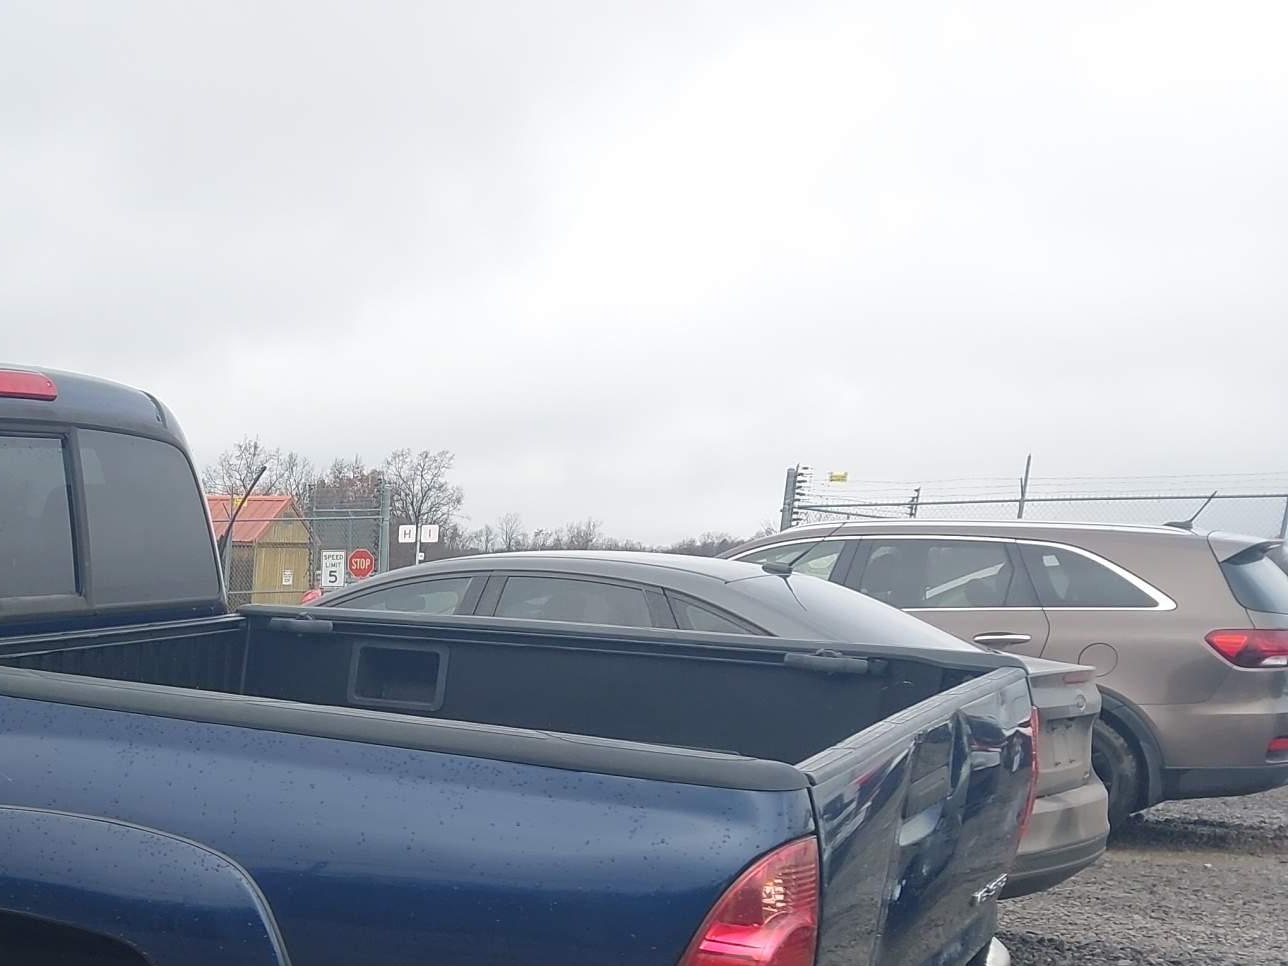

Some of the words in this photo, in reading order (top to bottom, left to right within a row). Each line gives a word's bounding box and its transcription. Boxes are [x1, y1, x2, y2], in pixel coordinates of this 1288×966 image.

[403, 528, 412, 539] H
[351, 558, 371, 569] STOP
[328, 570, 338, 584] 5
